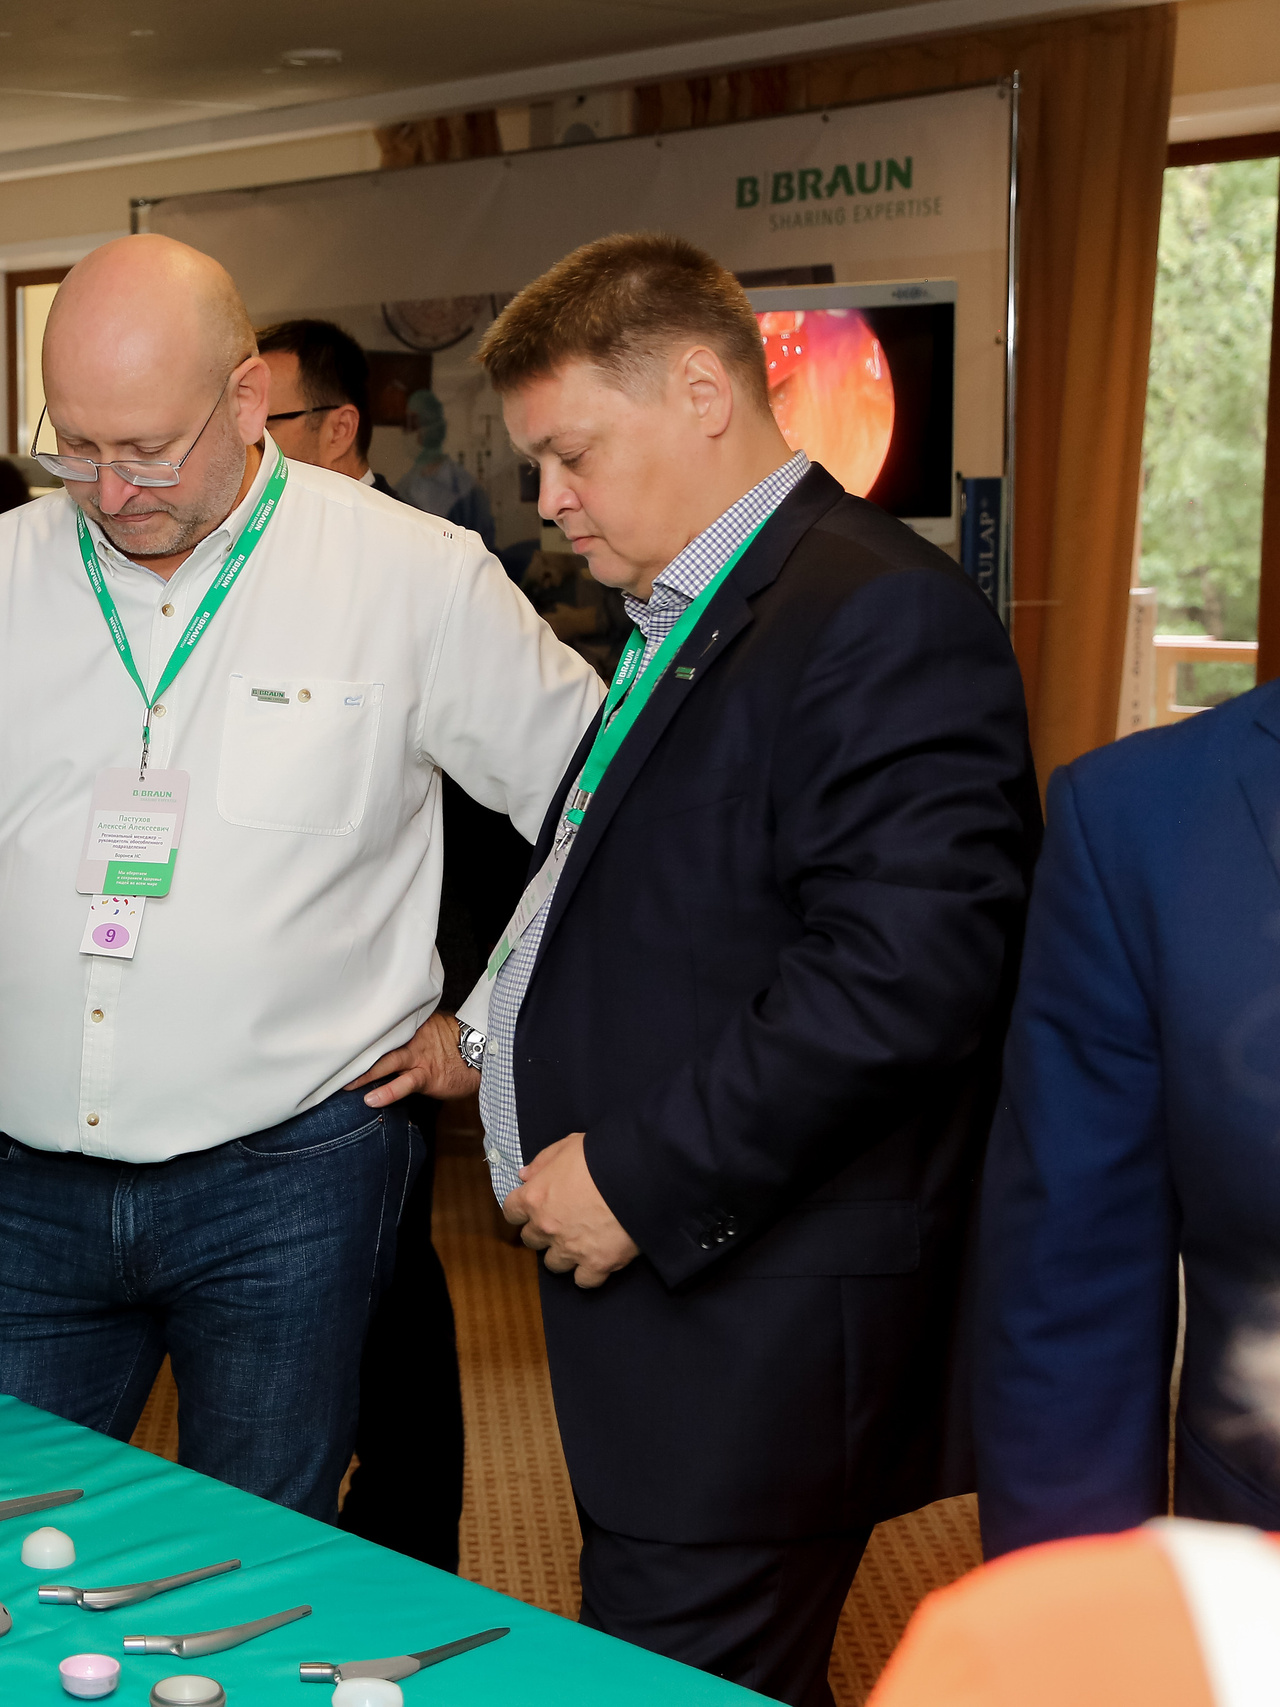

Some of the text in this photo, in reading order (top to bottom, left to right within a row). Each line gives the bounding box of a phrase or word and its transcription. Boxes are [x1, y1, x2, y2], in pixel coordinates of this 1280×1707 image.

[770, 156, 913, 204] BRAUN
[769, 196, 943, 232] SHARING EXPERTISE
[254, 504, 272, 531] BRAUN
[86, 559, 100, 586] BRAUN
[221, 559, 241, 588] BRAUN
[109, 616, 122, 644] BRAUN
[187, 617, 207, 646] BRAUN
[619, 649, 636, 678] BRAUN
[260, 690, 284, 698] BRAUN
[141, 790, 172, 798] BRAUN
[97, 822, 170, 832] Алексей Алексеевич
[119, 815, 151, 824] Пастухов
[104, 929, 116, 943] 9
